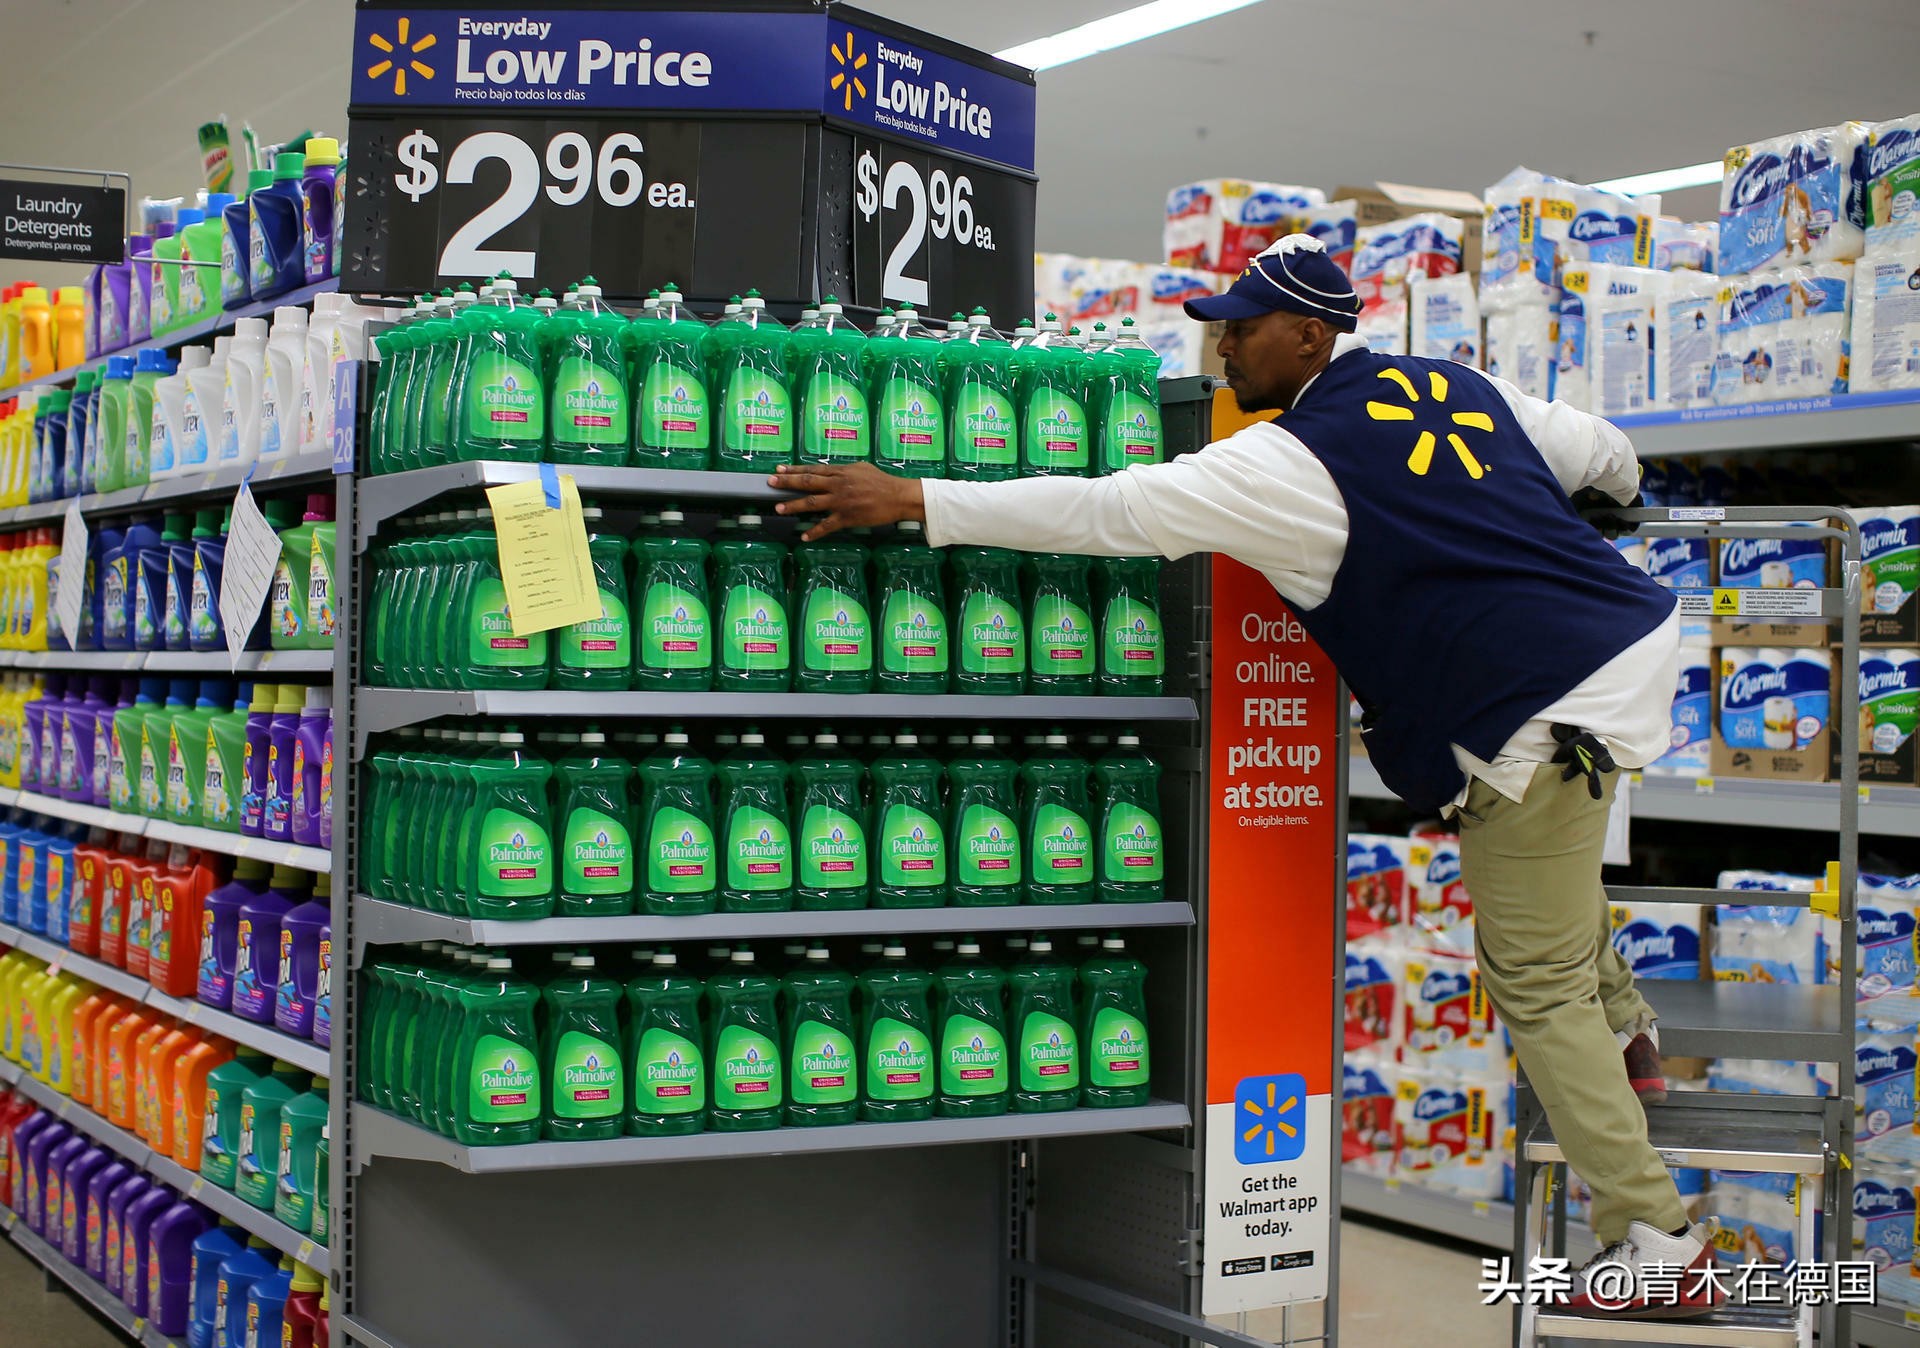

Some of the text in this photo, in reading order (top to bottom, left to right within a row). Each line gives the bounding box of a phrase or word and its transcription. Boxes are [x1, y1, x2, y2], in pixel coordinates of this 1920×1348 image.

[458, 17, 552, 41] Everyday
[455, 38, 713, 87] Low Price
[877, 41, 923, 76] Everyday
[455, 88, 586, 102] Precio bajo todos los días
[875, 63, 992, 140] Low Price
[874, 111, 891, 126] Precio
[891, 115, 903, 130] bajo
[903, 118, 918, 134] todos
[926, 124, 938, 138] días
[647, 182, 695, 208] ea.
[16, 194, 82, 219] Laundry
[5, 215, 92, 239] Detergents
[5, 237, 91, 253] Detergentes para ropa
[974, 224, 996, 251] ea.
[338, 368, 352, 410] A
[483, 390, 534, 406] Palmolive
[566, 394, 617, 410] Palmolive
[654, 400, 701, 415] Palmolive
[736, 404, 786, 419] Palmolive
[1756, 404, 1774, 414] items
[1775, 404, 1785, 413] on
[1786, 401, 1798, 411] the
[1799, 401, 1811, 413] top
[815, 408, 863, 424] Palmolive
[890, 412, 937, 428] Palmolive
[964, 416, 1011, 432] Palmolive
[1038, 420, 1082, 436] Palmolive
[1117, 424, 1158, 440] Palmolive
[334, 426, 353, 463] 28
[1860, 524, 1908, 556] harmin
[1878, 561, 1917, 573] Sensitive
[654, 620, 704, 635] Palmolive
[736, 622, 782, 637] Palmolive
[816, 623, 865, 638] Palmolive
[895, 625, 941, 640] Palmolive
[973, 626, 1018, 641] Palmolive
[1043, 628, 1087, 643] Palmolive
[1117, 629, 1159, 644] Palmolive
[1236, 653, 1315, 683] online.
[1731, 667, 1787, 703] Charmin
[1859, 666, 1907, 697] harmin
[1243, 698, 1307, 727] FREE
[1878, 703, 1916, 715] Sensitive
[1228, 737, 1321, 776] pick up
[1223, 781, 1323, 809] at store.
[1238, 815, 1309, 829] On eligible items.
[660, 844, 708, 858] Palmolive
[739, 843, 786, 856] Palmolive
[812, 841, 859, 854] Palmolive
[893, 839, 938, 852] Palmolive
[970, 840, 1015, 853] Palmolive
[1043, 839, 1088, 852] Palmolive
[1117, 838, 1157, 850] Palmolive
[491, 846, 542, 861] Palmolive
[575, 845, 625, 859] Palmolive
[1031, 1044, 1074, 1058] Palmolive
[1102, 1042, 1143, 1055] Palmolive
[803, 1056, 850, 1070] Palmolive
[879, 1054, 925, 1067] Palmolive
[952, 1050, 999, 1063] Palmolive
[647, 1066, 697, 1079] Palmolive
[727, 1062, 774, 1075] Palmolive
[482, 1074, 532, 1087] Palmolive
[564, 1070, 615, 1083] Palmolive
[1242, 1173, 1297, 1193] Get the
[1220, 1195, 1318, 1218] Walmart app
[1245, 1219, 1292, 1238] today.
